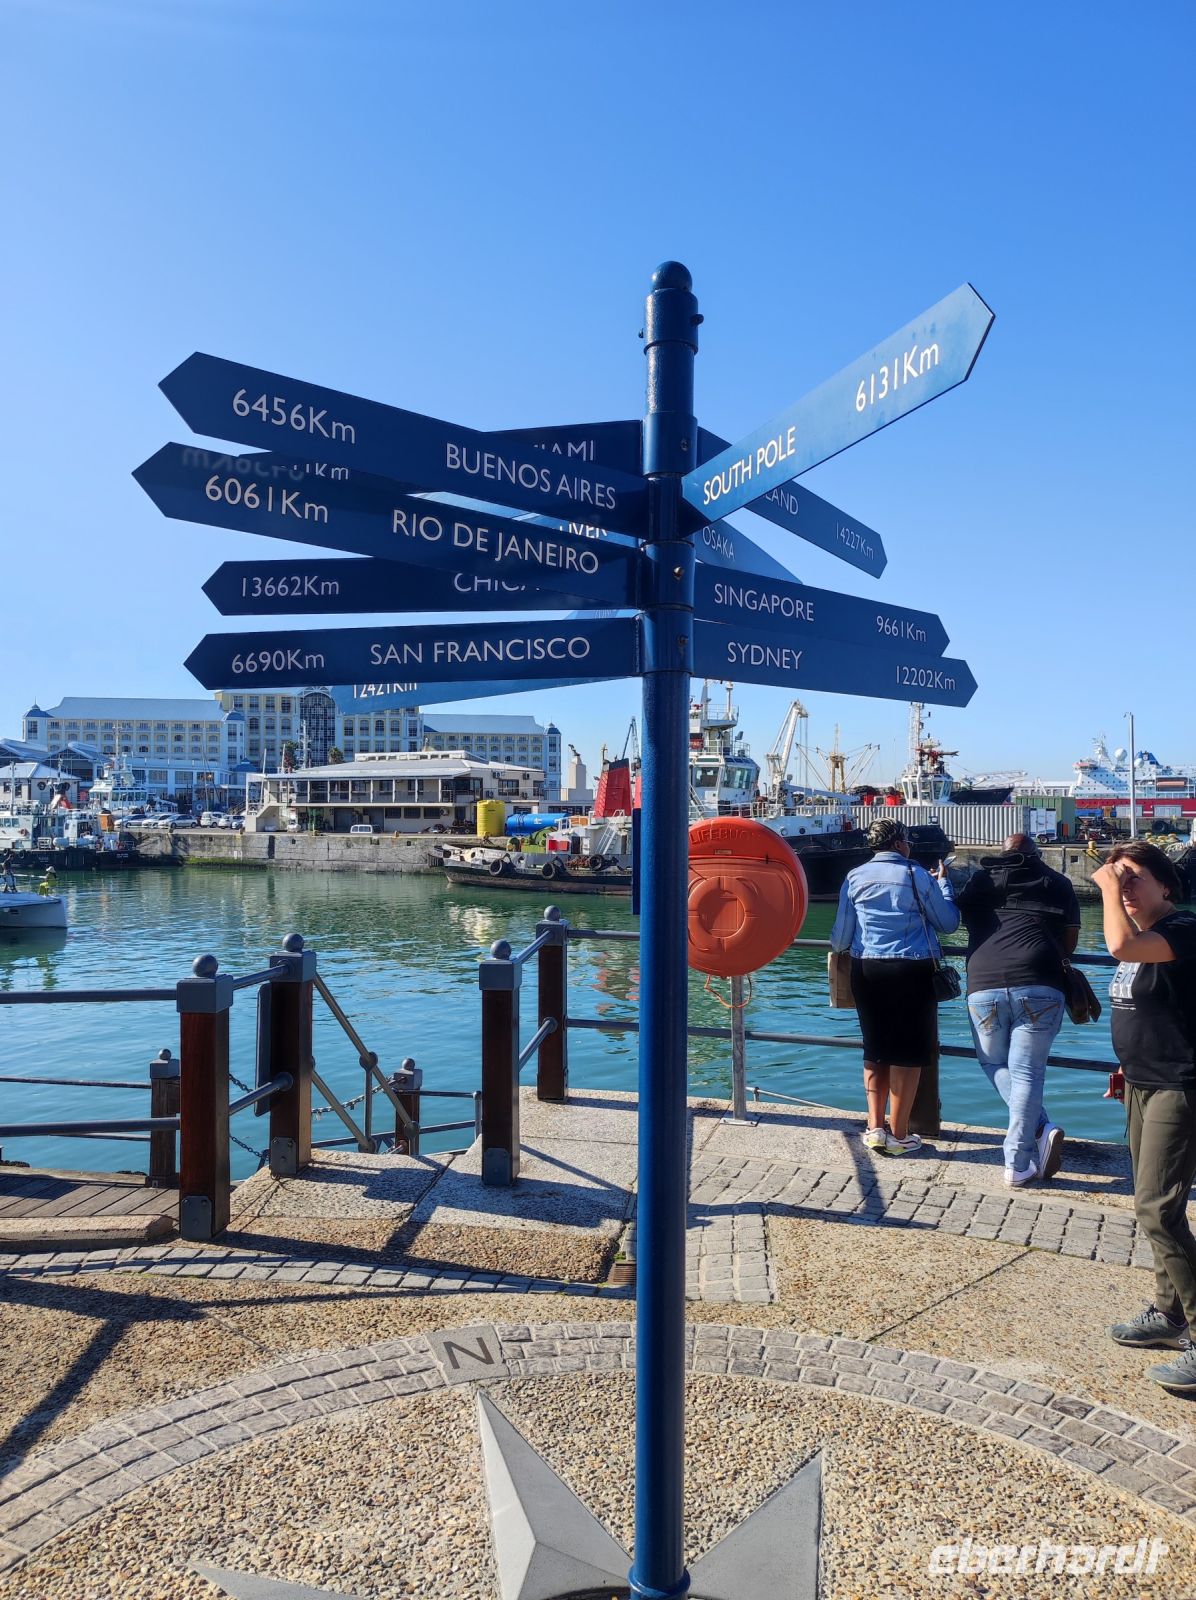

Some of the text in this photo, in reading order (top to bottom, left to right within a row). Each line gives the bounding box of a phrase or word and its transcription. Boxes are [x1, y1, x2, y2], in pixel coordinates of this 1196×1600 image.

[704, 344, 939, 505] SOUTH POLE 6131Km
[232, 389, 616, 510] 6456Km BUENOS AIRES
[205, 475, 599, 574] 6061Km RIO DE JANEIRO
[703, 526, 736, 562] OSAKA
[836, 522, 875, 560] 14227Km
[242, 576, 340, 597] 13662Km
[714, 583, 927, 642] SINGAPORE 9661Km
[231, 637, 591, 673] 6690Km SAN FRANCISCO
[727, 642, 956, 691] SYDNEY 12202Km
[443, 1337, 494, 1369] N
